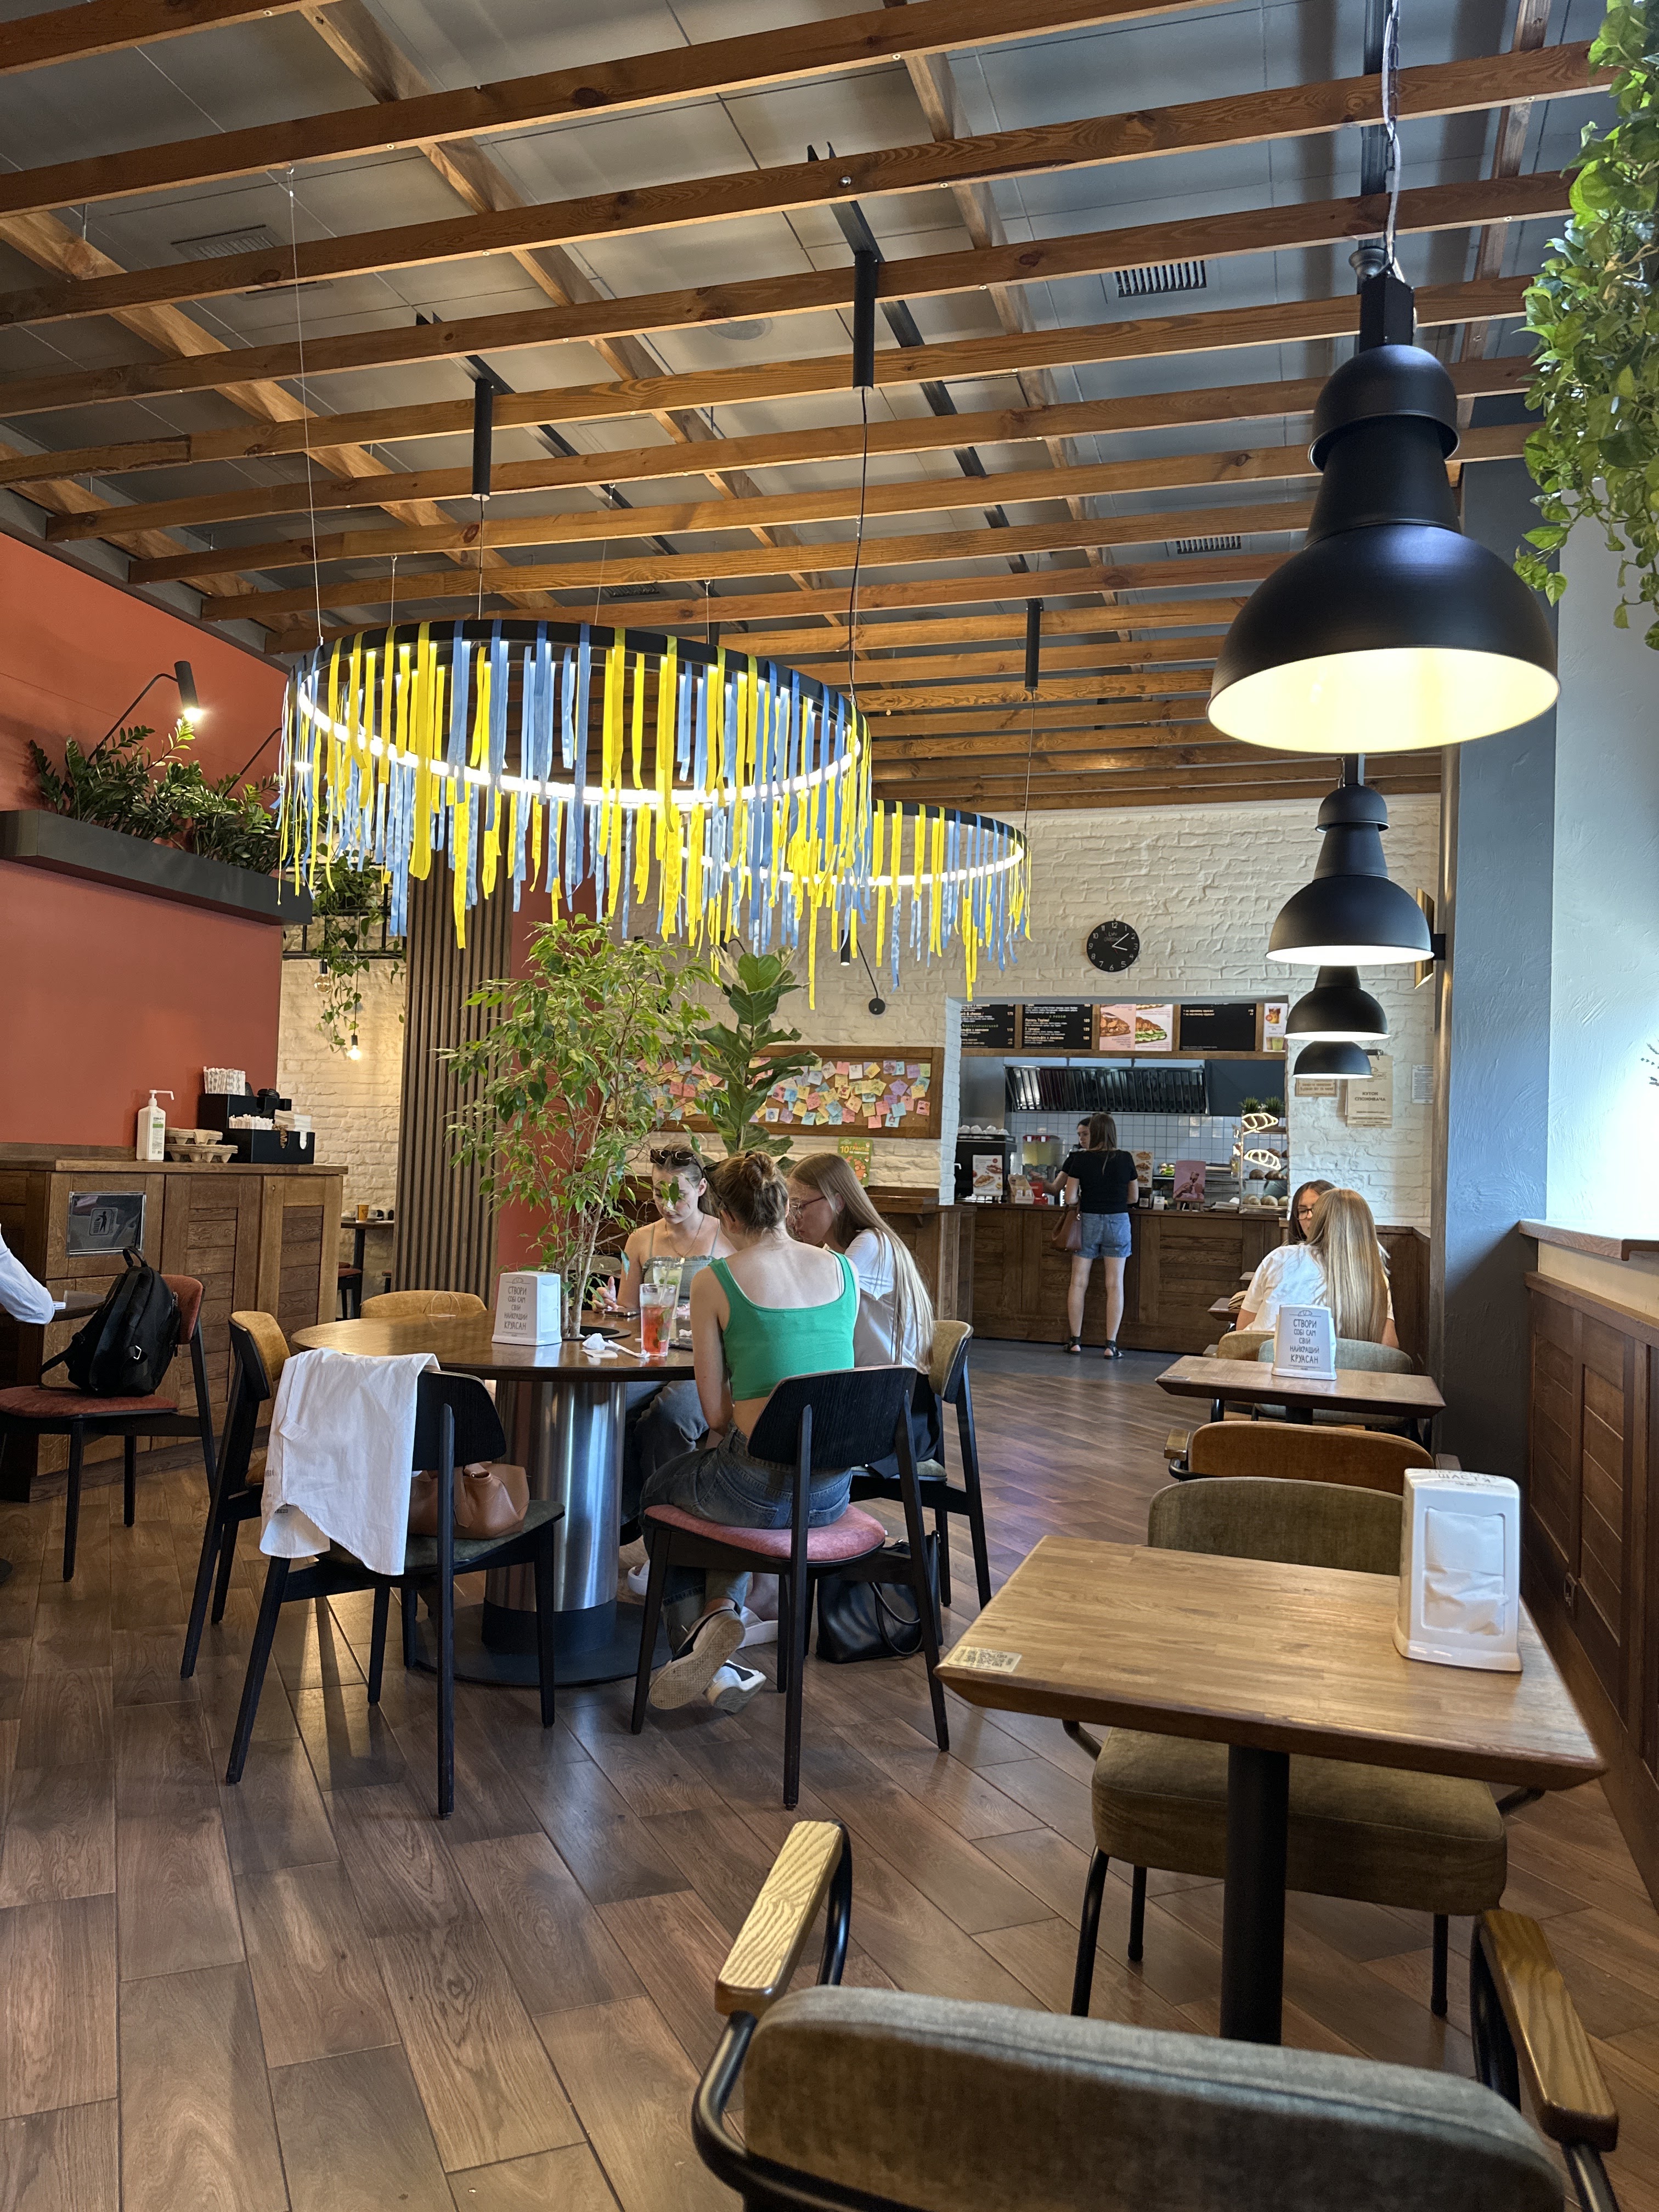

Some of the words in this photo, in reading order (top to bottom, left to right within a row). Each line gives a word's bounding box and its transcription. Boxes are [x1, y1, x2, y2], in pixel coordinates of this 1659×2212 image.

[508, 1286, 527, 1295] СТВОРИ
[504, 1312, 528, 1321] НАЙКРАЩИЙ
[504, 1321, 527, 1330] КРУАСАН
[1293, 1319, 1317, 1329] СТВОРИ
[1290, 1345, 1320, 1354] НАЙКРАЩИЙ
[1290, 1354, 1319, 1364] КРУАСАН
